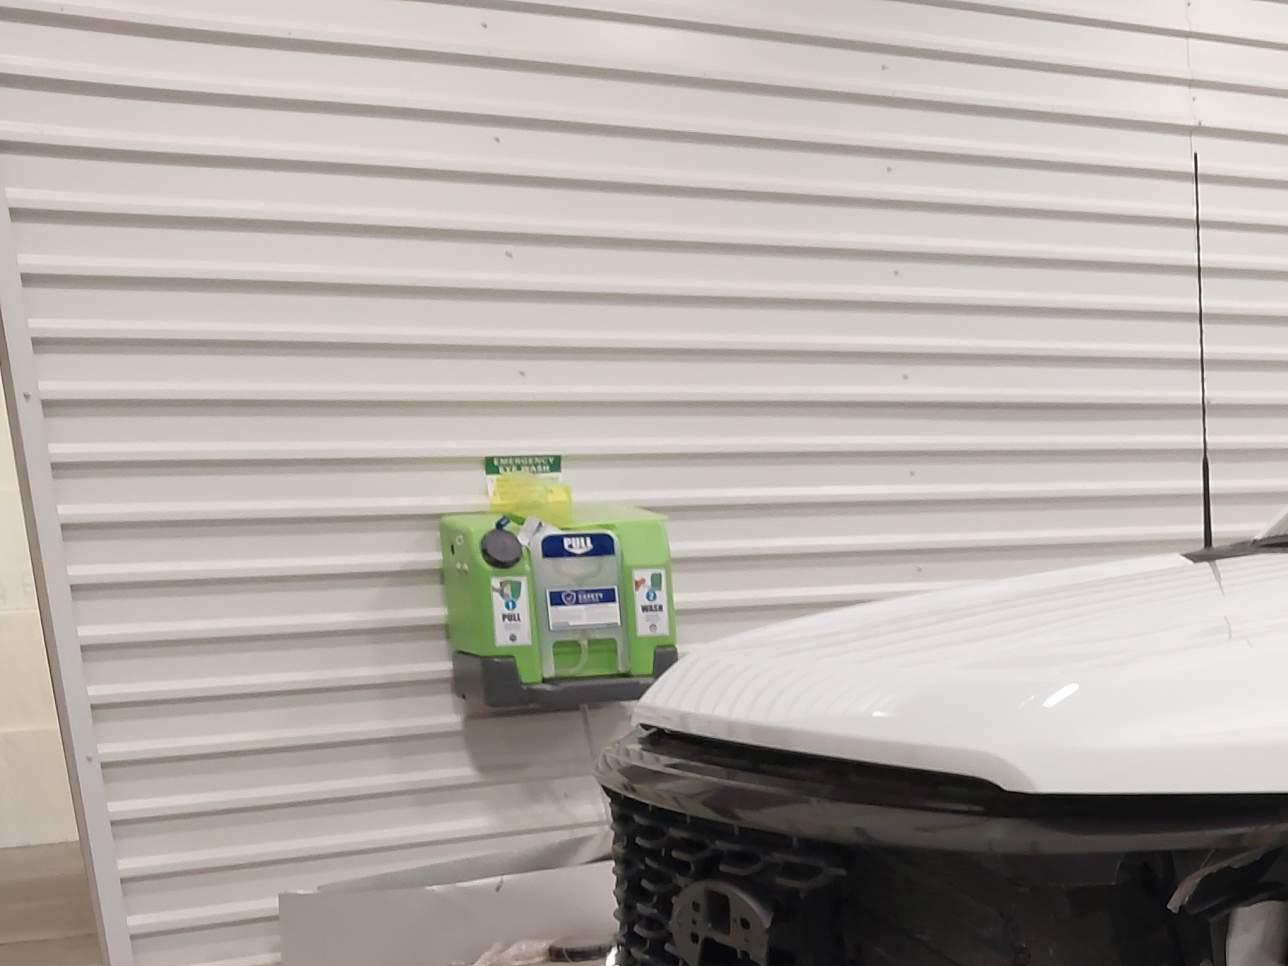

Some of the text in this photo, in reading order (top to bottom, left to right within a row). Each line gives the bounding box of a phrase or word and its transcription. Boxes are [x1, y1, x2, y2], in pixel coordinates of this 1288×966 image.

[493, 456, 555, 466] EMERGENCY
[521, 464, 551, 473] WASH
[563, 536, 594, 554] PULL
[641, 604, 663, 613] WASH
[502, 613, 520, 622] PULL
